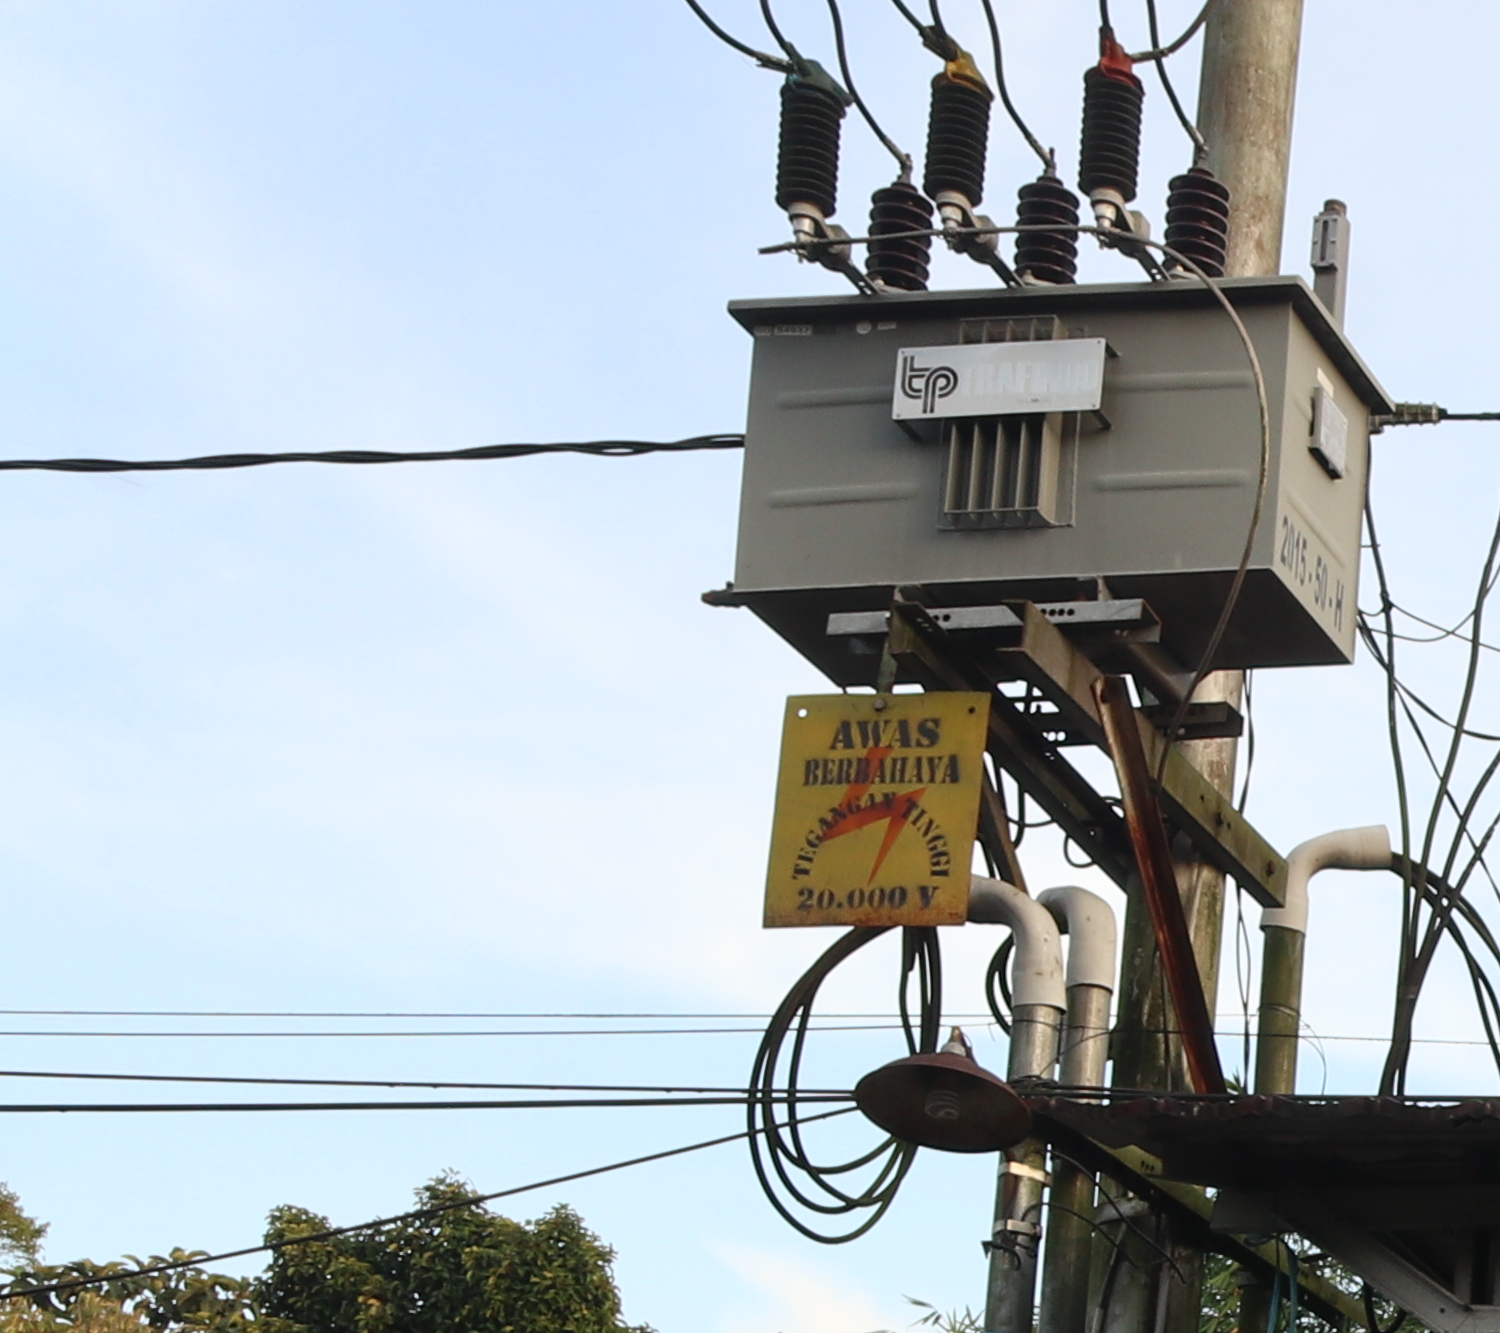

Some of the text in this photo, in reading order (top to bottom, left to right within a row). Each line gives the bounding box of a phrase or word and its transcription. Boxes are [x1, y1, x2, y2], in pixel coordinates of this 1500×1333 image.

[1281, 515, 1308, 586] 2015
[829, 718, 941, 749] AWAS
[803, 754, 960, 786] BERBAHAYA
[792, 792, 951, 880] TEGANGAN TINGGI
[797, 885, 939, 910] 20.000 V
